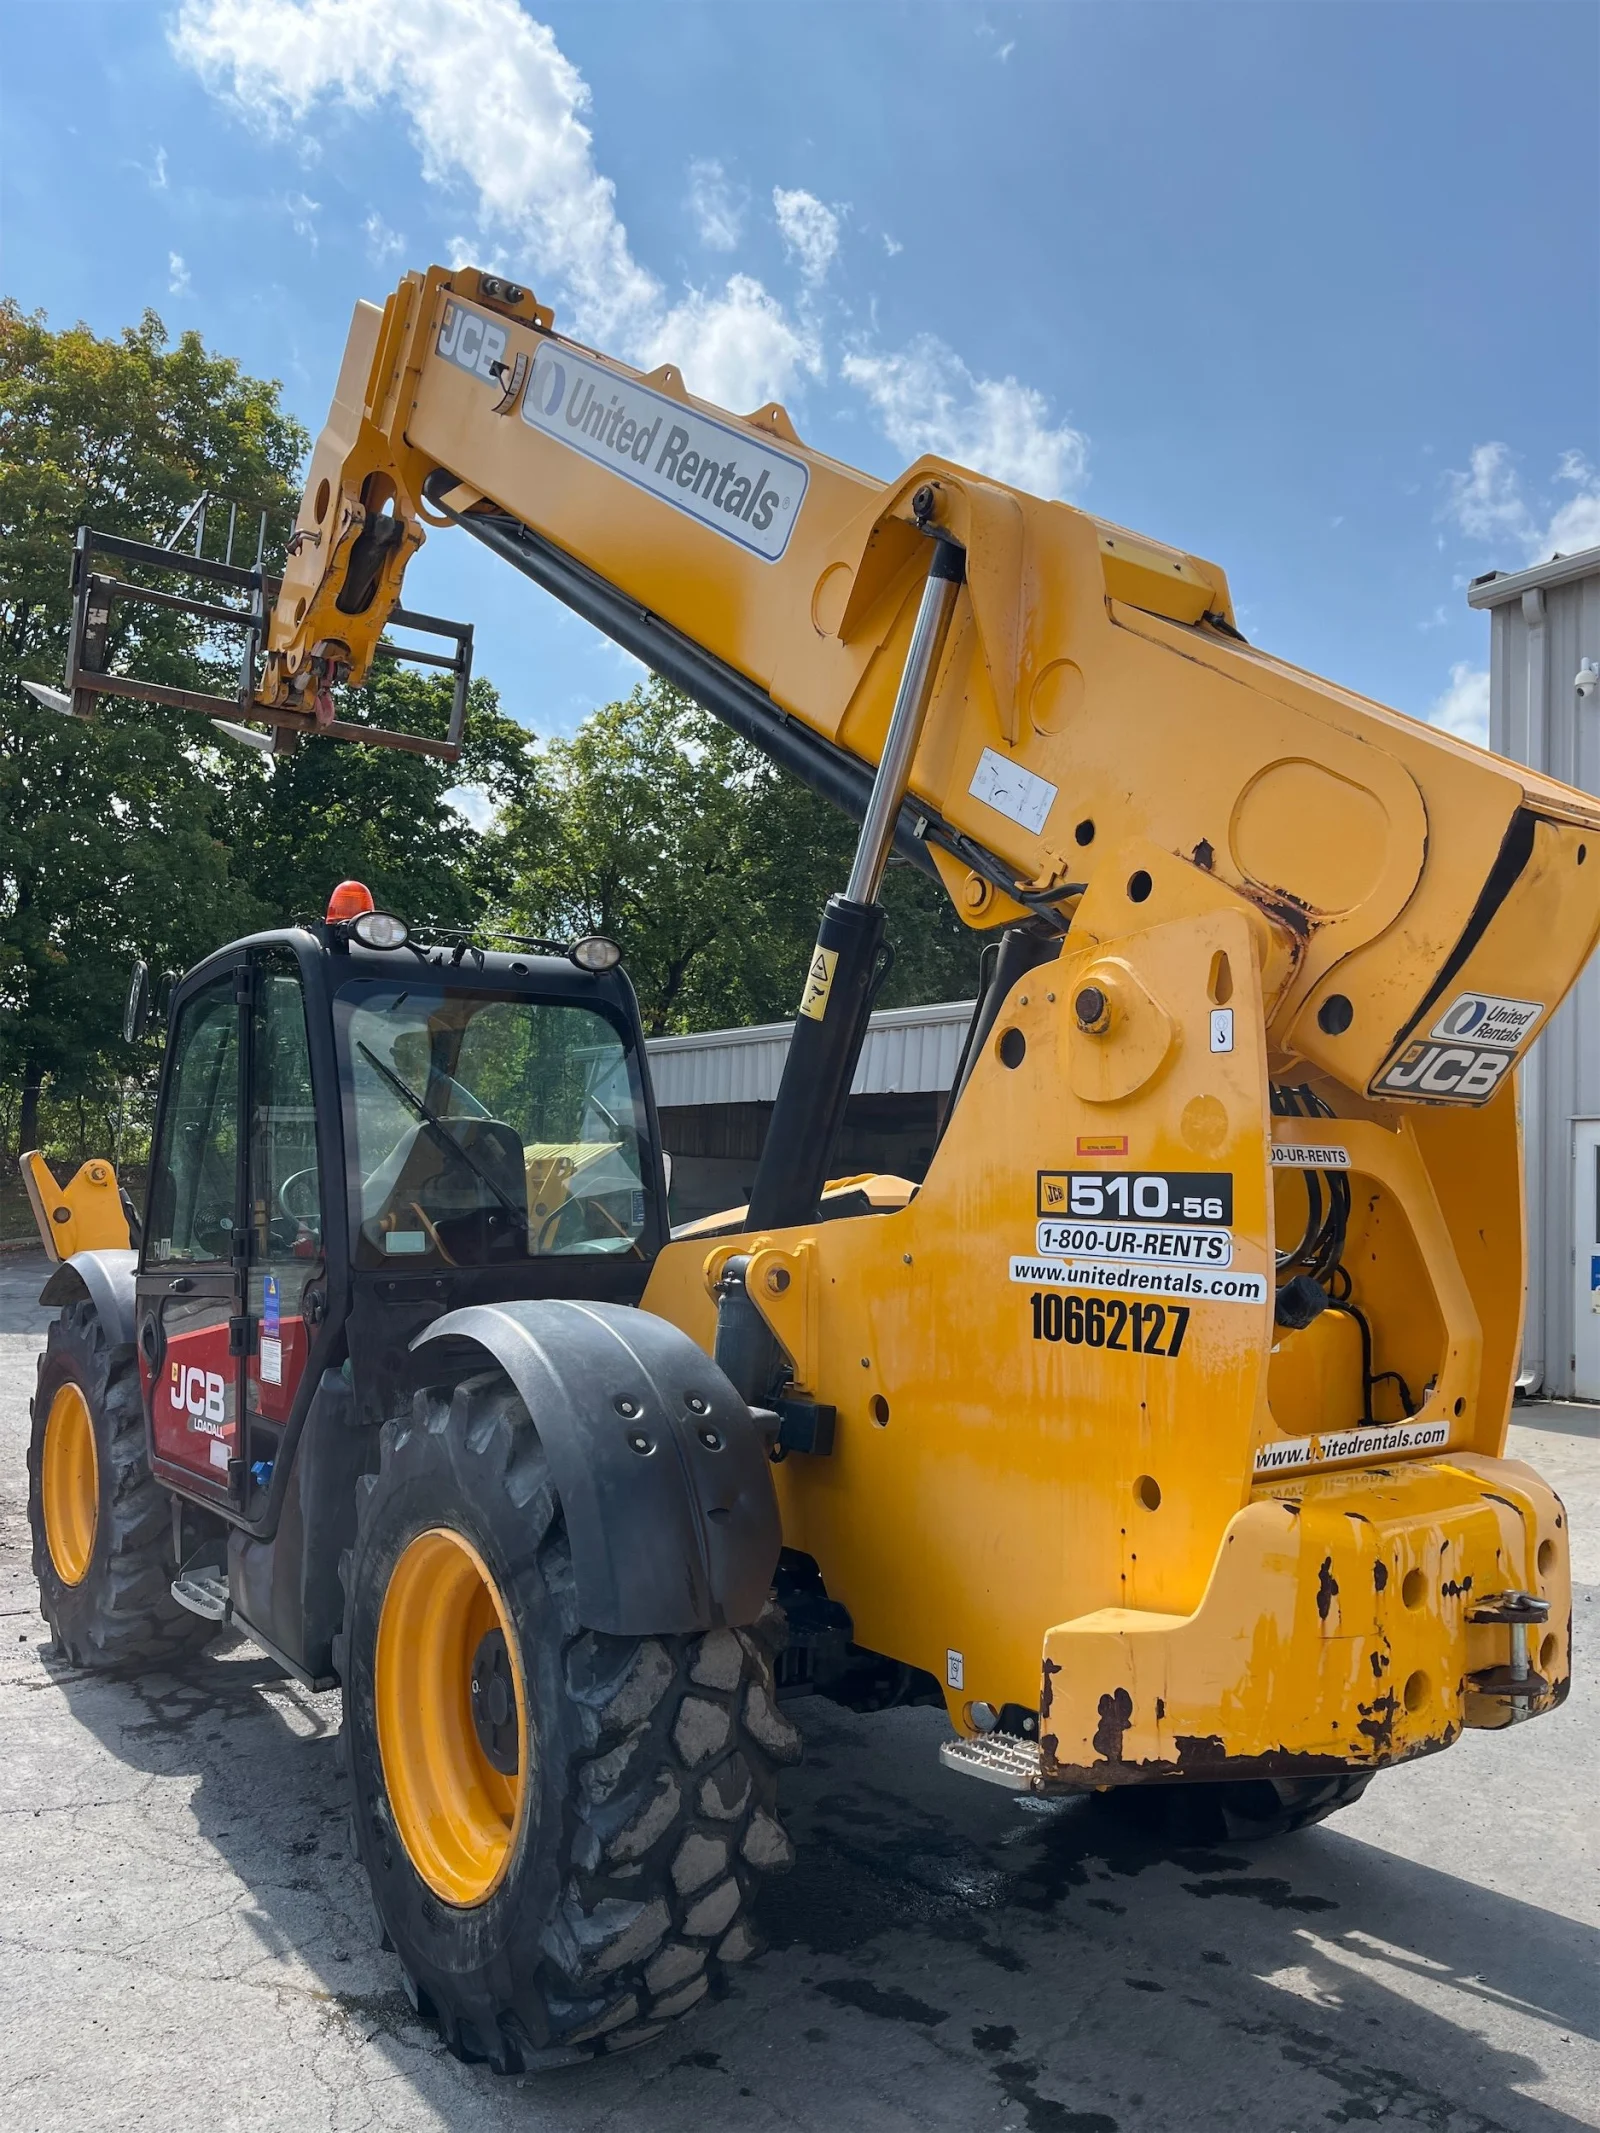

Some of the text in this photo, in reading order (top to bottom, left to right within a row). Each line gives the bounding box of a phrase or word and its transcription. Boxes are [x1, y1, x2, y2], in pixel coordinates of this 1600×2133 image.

[439, 309, 506, 380] JCB
[565, 378, 662, 466] United
[655, 424, 780, 531] Rentals
[1486, 1005, 1532, 1026] United
[1473, 1023, 1522, 1043] Rentals
[1386, 1047, 1509, 1094] JCB
[1047, 1185, 1064, 1203] JCB
[1043, 1228, 1223, 1259] 1-800-UR-RENTS
[1014, 1264, 1260, 1298] www.unitedrentals.com
[1030, 1292, 1190, 1358] 10662127
[170, 1365, 225, 1422] JCB
[194, 1418, 224, 1439] LOADALL
